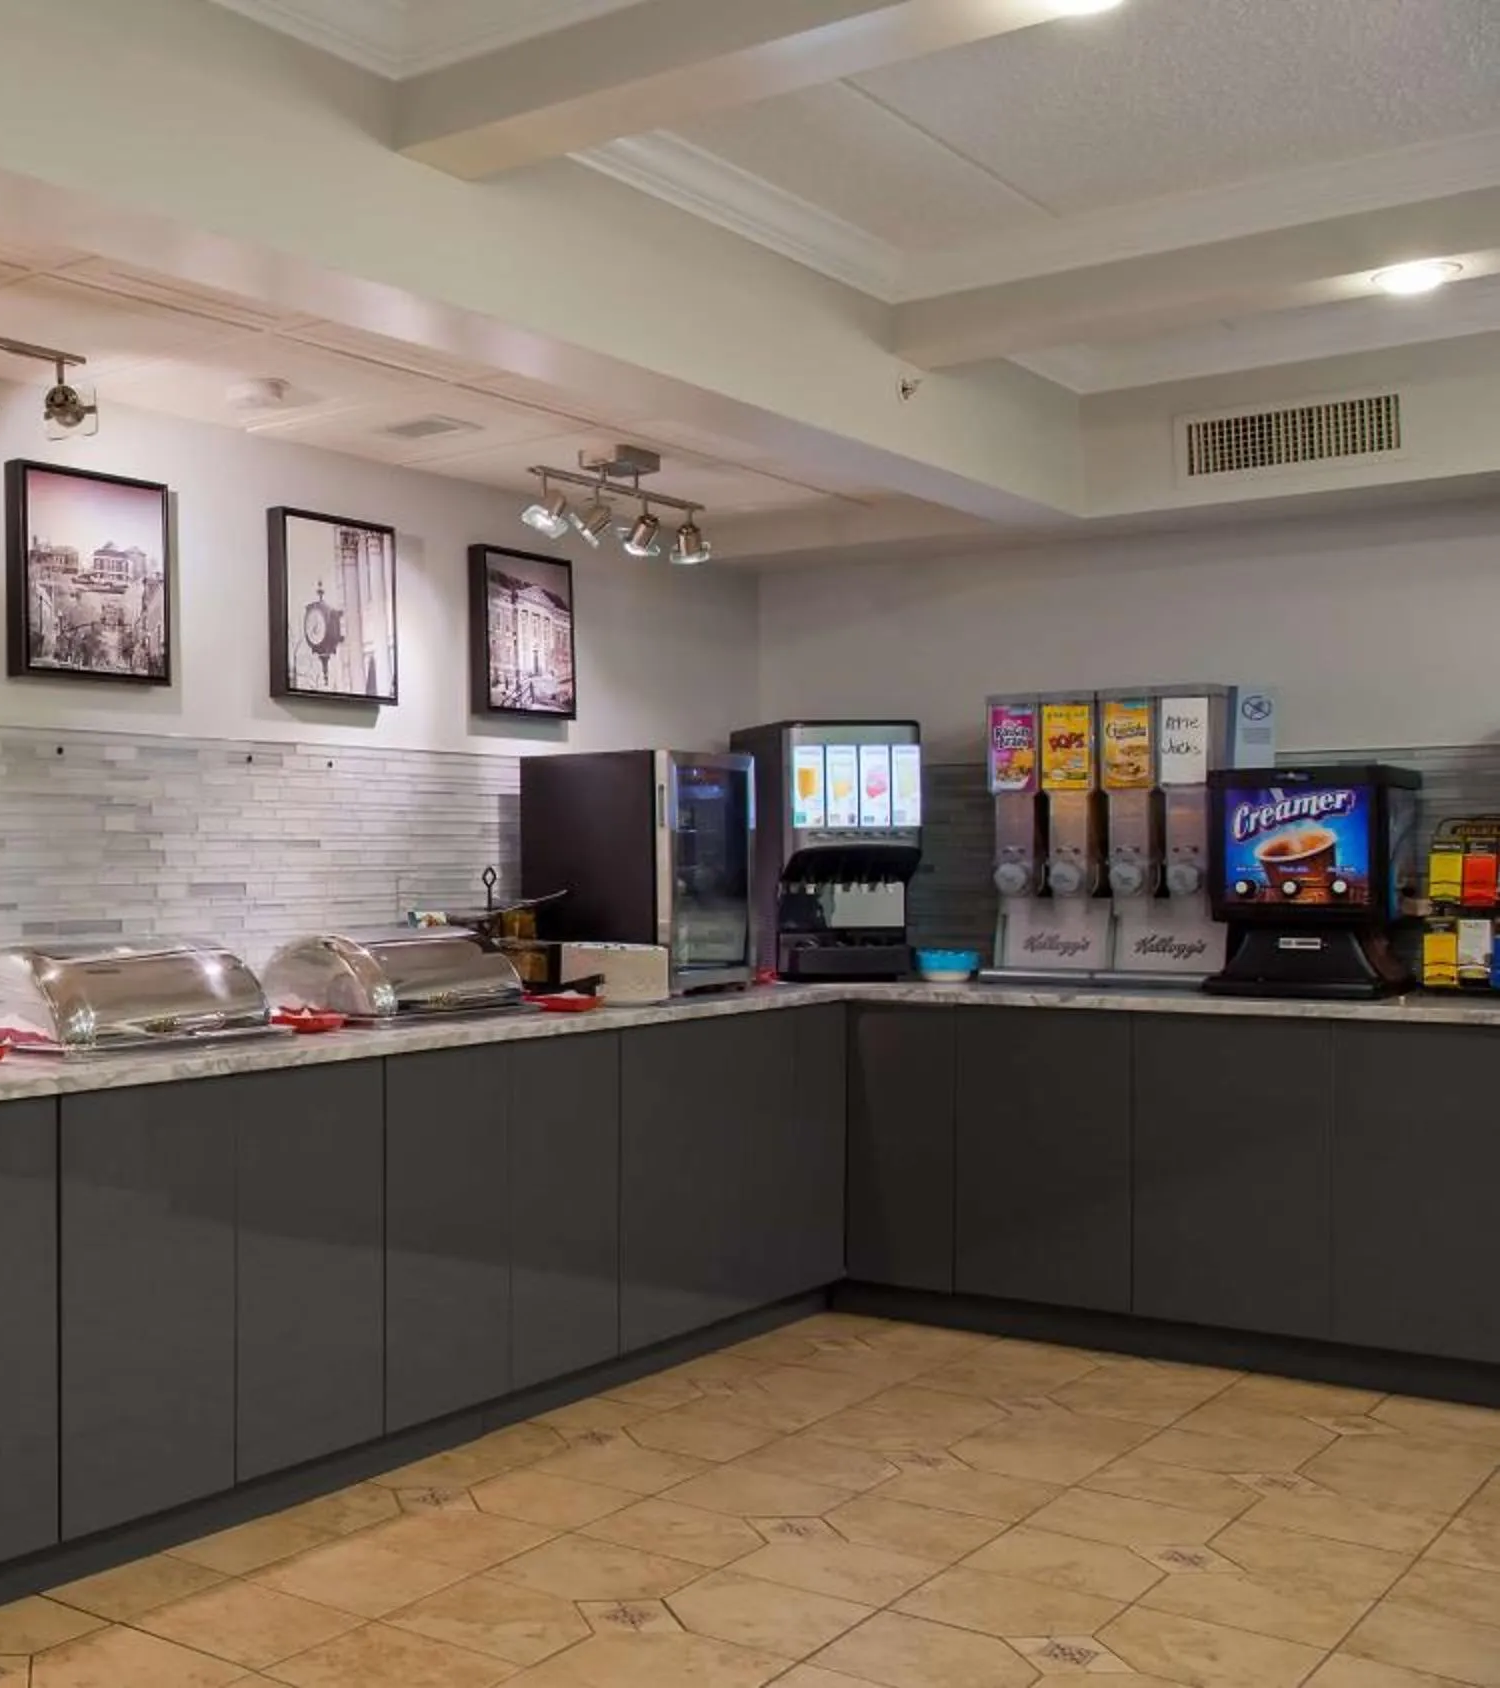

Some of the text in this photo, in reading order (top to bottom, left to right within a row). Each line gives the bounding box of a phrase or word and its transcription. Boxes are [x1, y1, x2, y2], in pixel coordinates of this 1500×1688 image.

[1233, 789, 1350, 841] Creamer
[1022, 932, 1091, 955] Kellogg's
[1133, 934, 1206, 959] Kellogg's
